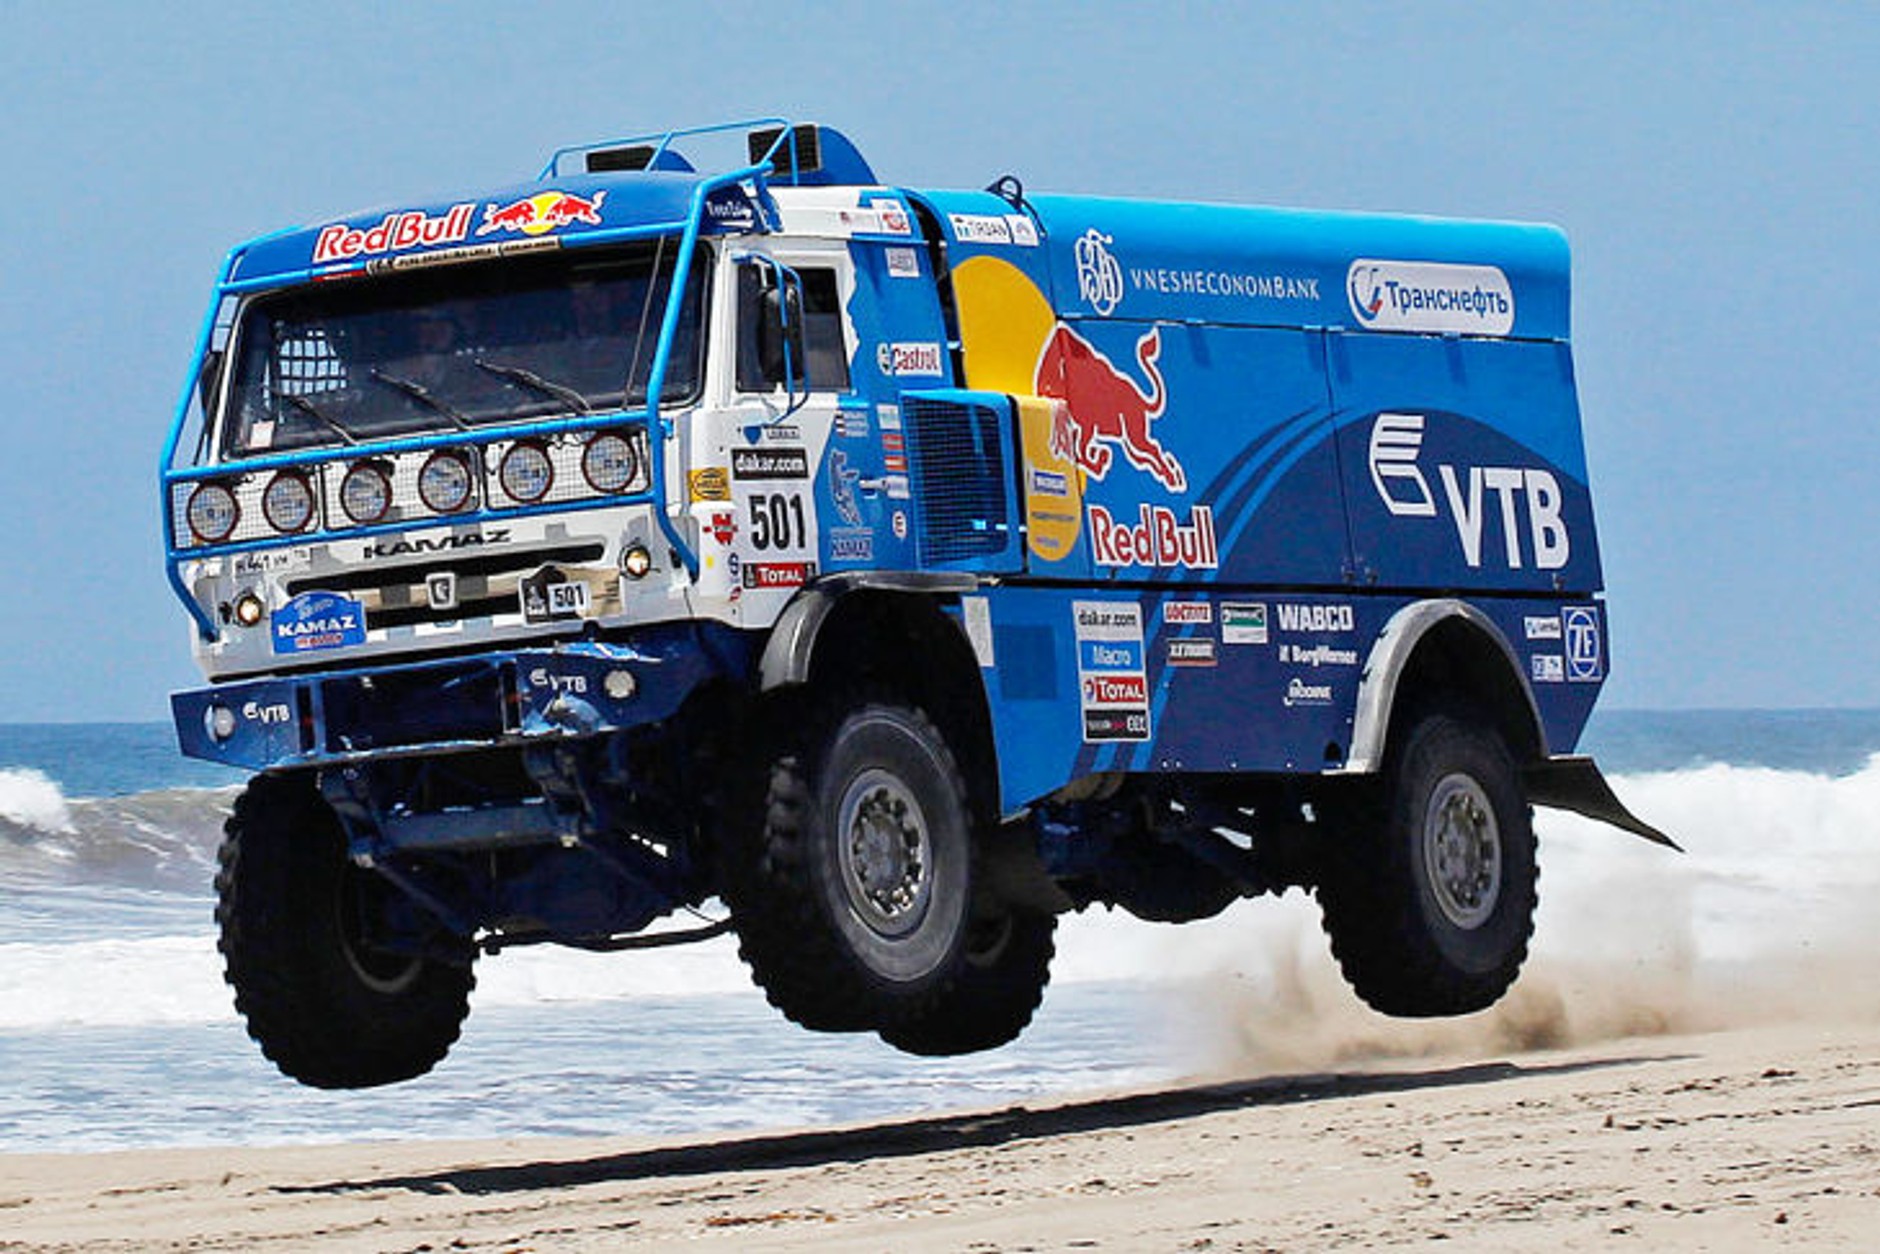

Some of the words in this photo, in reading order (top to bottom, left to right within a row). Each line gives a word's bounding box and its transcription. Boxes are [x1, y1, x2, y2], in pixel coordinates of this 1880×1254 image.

[312, 214, 397, 263] Red
[392, 203, 476, 249] Bull
[1130, 268, 1320, 300] VNESHECONOMBANK
[1385, 281, 1509, 317] Транснефть
[892, 346, 938, 371] Castrol
[735, 452, 805, 472] dakar.com
[748, 493, 806, 551] 501
[1438, 464, 1569, 569] VTB
[362, 528, 511, 558] KAMAZ
[1088, 504, 1155, 567] Red
[1153, 505, 1219, 569] Bull
[758, 566, 804, 584] TOTAL
[553, 583, 584, 608] 501
[277, 614, 357, 637] KAMAZ
[1078, 609, 1137, 628] dakar.com
[1276, 603, 1354, 632] WABCO
[549, 674, 587, 694] VTB
[1098, 679, 1145, 699] TOTAL
[260, 703, 290, 725] VTB
